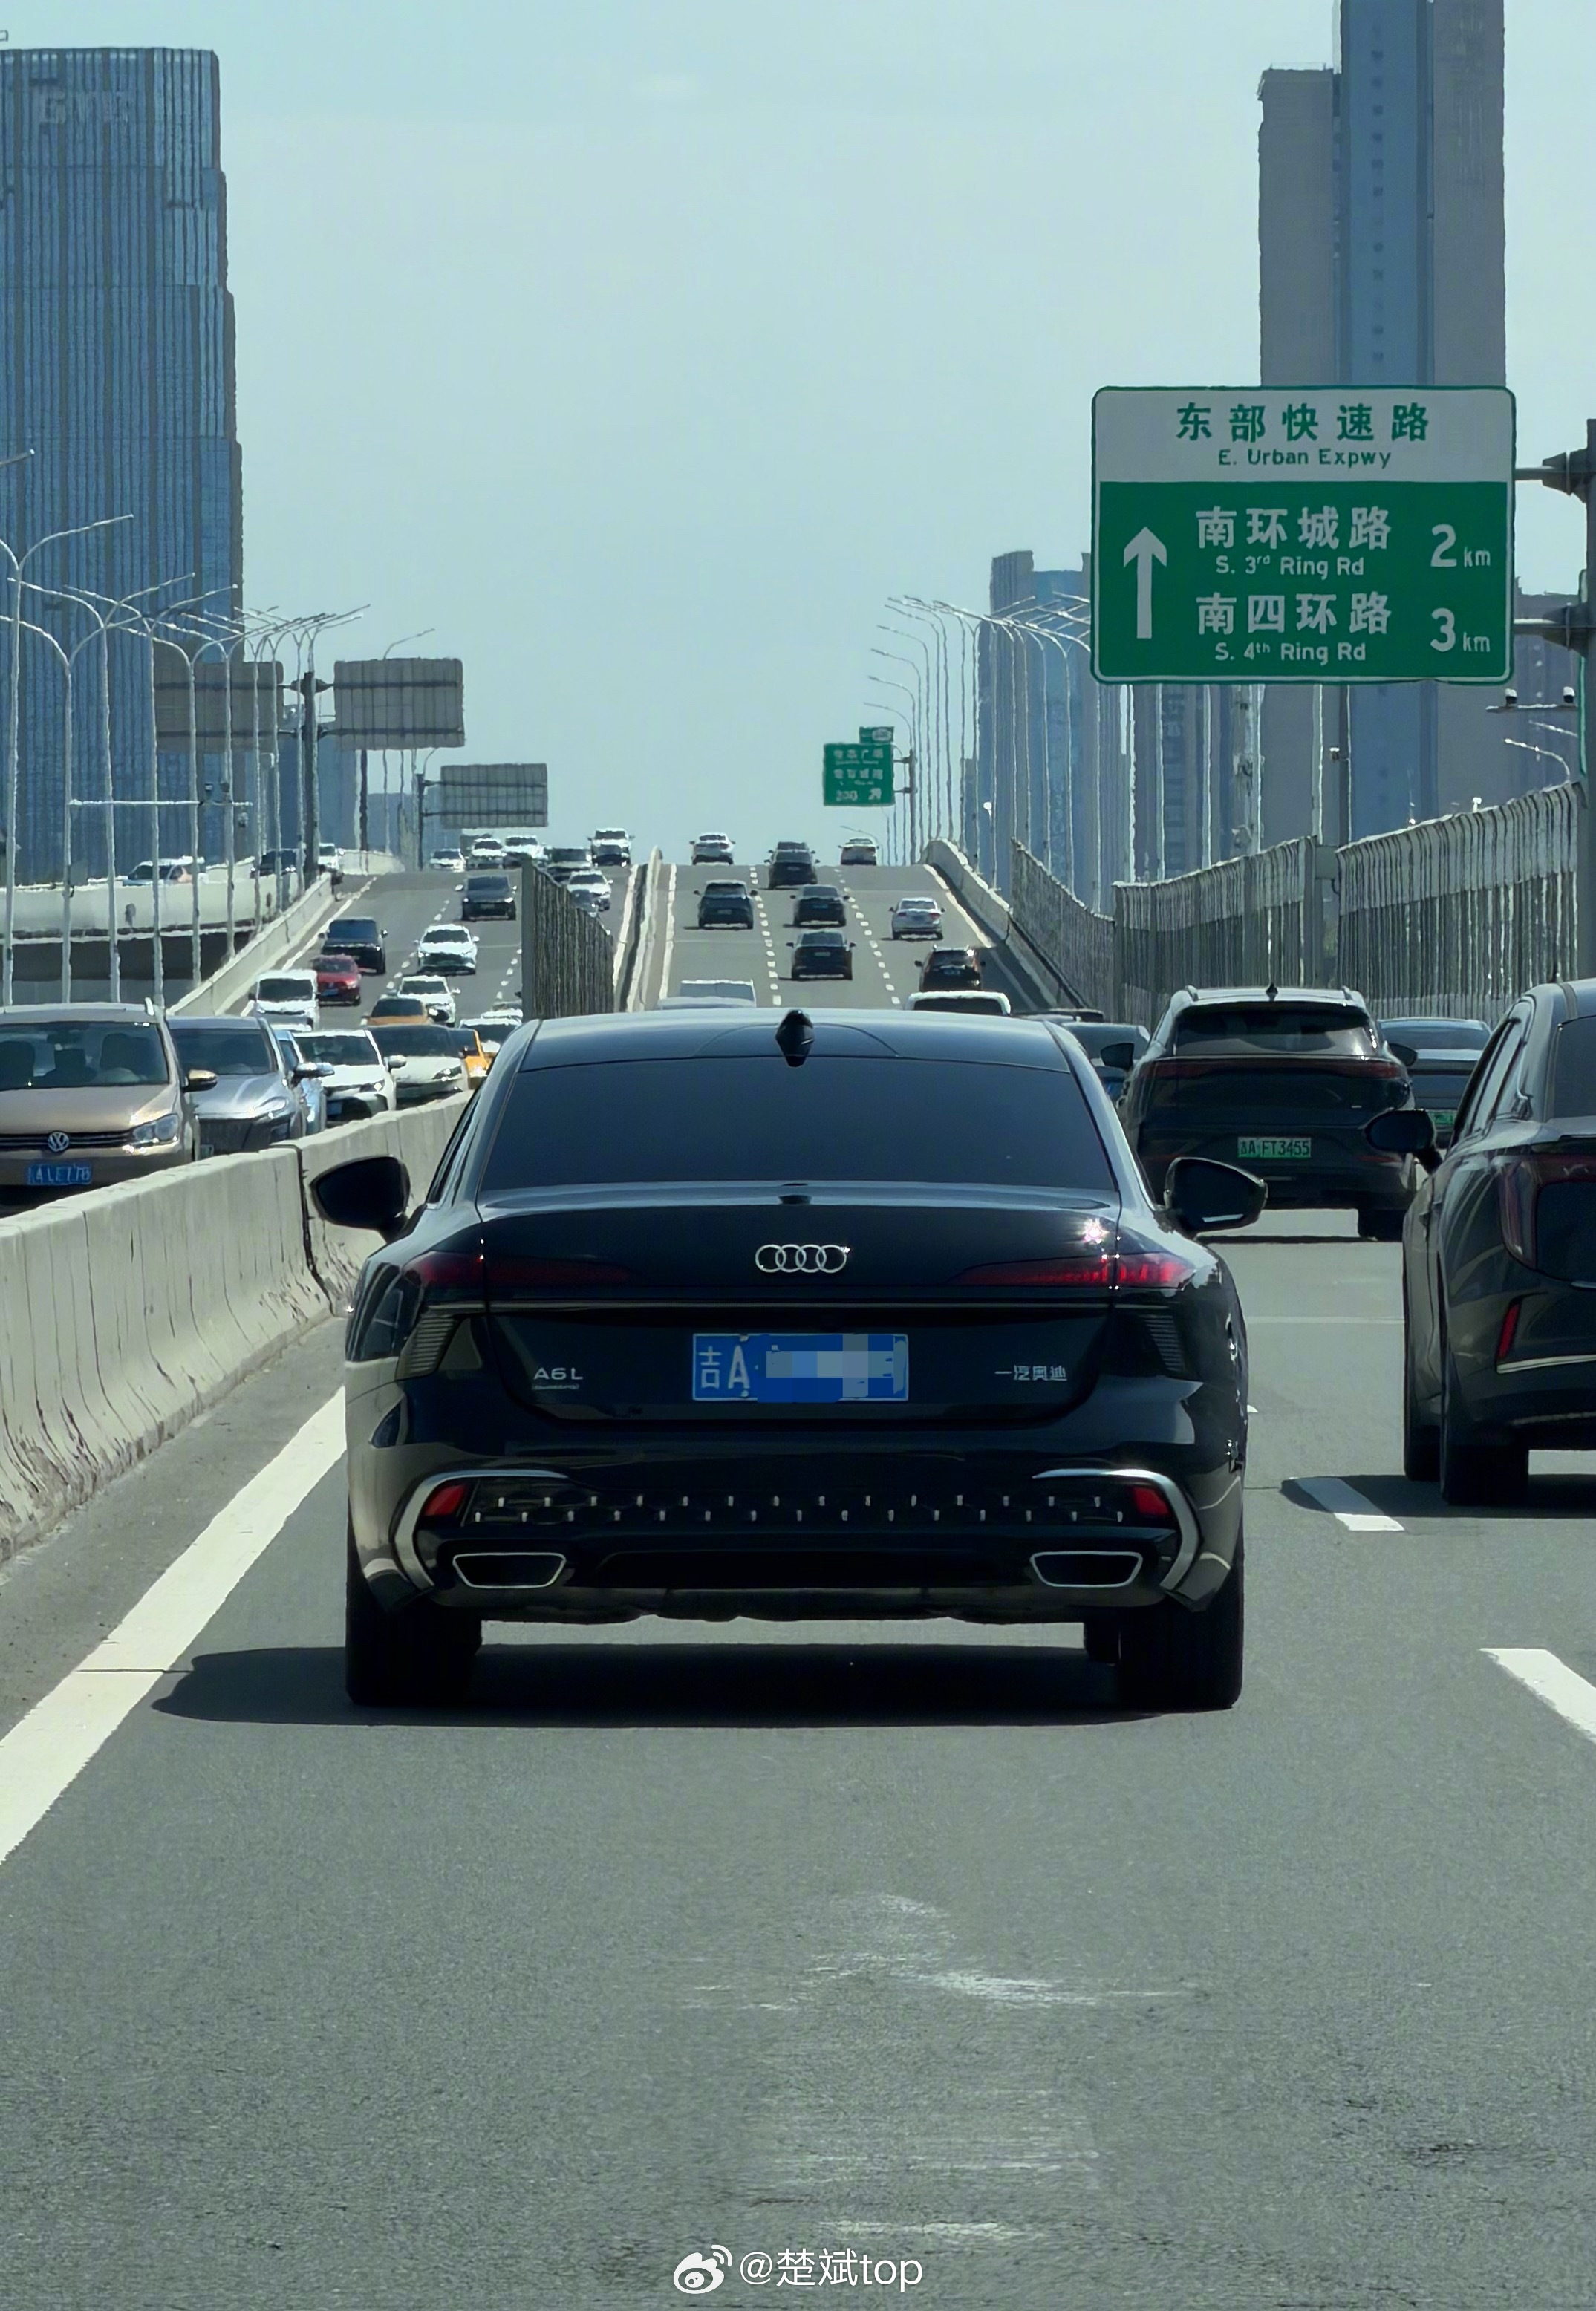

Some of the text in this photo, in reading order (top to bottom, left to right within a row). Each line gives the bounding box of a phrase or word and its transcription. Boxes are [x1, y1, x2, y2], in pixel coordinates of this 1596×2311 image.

[1176, 402, 1429, 443] 东部快速路
[1218, 448, 1391, 469] E. Urban Expwy
[1196, 506, 1391, 550] 南环城路
[1430, 524, 1491, 567] 2 km
[1216, 555, 1364, 580] S. 3rd Ring Rd
[1196, 591, 1391, 635] 南四环路
[1430, 607, 1491, 653] 3 km
[1215, 642, 1367, 665] S. 4th Ring Rd
[533, 1366, 584, 1381] A6L
[994, 1364, 1068, 1381] 一汽奥迪
